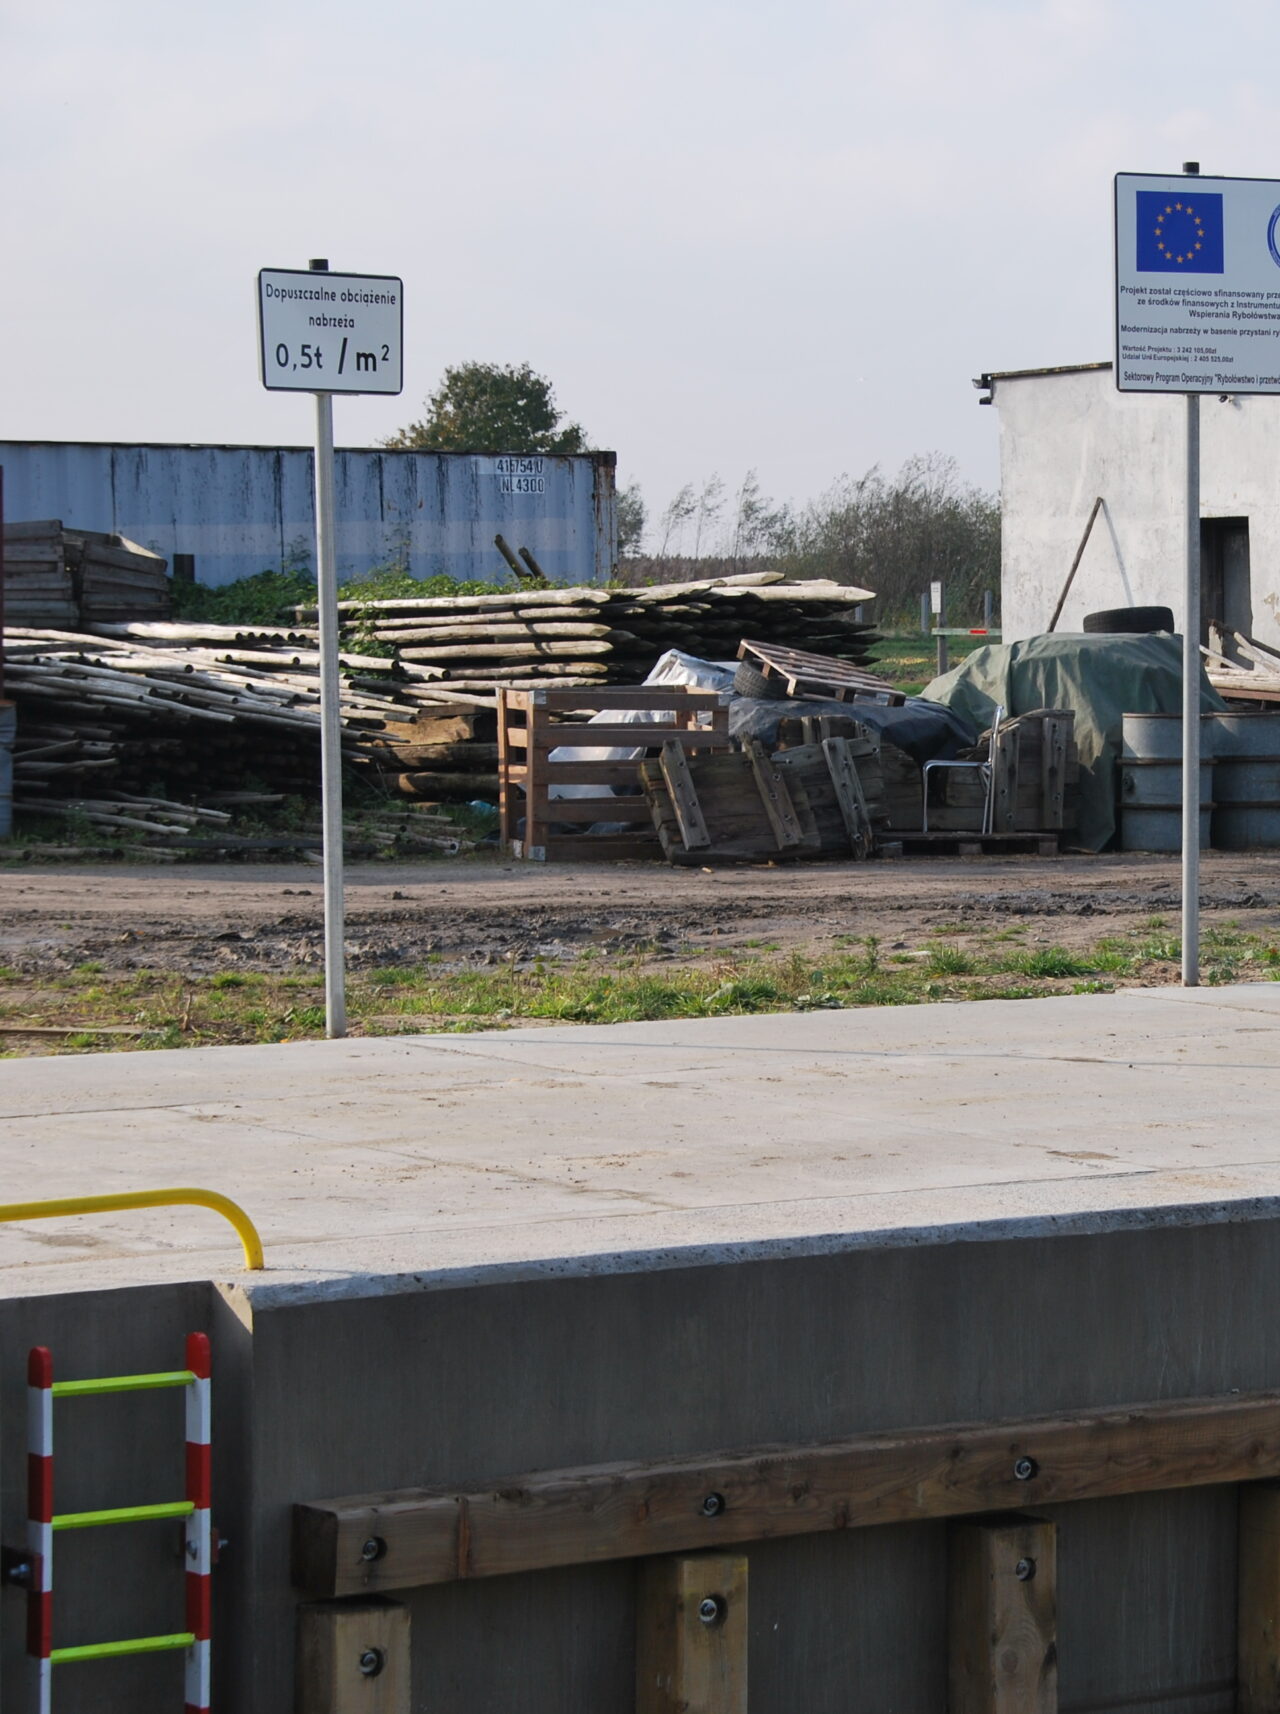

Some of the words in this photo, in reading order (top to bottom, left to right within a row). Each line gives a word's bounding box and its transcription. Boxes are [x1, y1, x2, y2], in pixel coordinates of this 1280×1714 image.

[266, 283, 337, 303] Dopuszczalne
[340, 289, 397, 307] obciążenie
[1120, 286, 1147, 296] Projekt
[1174, 289, 1212, 298] częściowo
[1214, 290, 1264, 300] sfinansowany
[1148, 298, 1180, 306] środków
[1182, 299, 1228, 309] finansowych
[1236, 301, 1280, 310] Instrumentu
[308, 312, 355, 329] nabrzeża
[1188, 310, 1230, 319] Wspierania
[1232, 311, 1280, 320] Rybołówstwa
[1121, 324, 1168, 335] Modernizacja
[1170, 326, 1201, 336] nabrzeży
[1210, 327, 1238, 336] basenie
[1239, 328, 1272, 336] przystani
[275, 342, 323, 371] 0,5t
[337, 337, 348, 374] /
[1148, 346, 1172, 354] Projektu
[1124, 371, 1154, 384] Sektorowy
[1156, 372, 1180, 384] Program
[1182, 373, 1213, 385] Operacyjny
[1215, 374, 1255, 386] "Rybołówstwo
[1256, 375, 1258, 384] i
